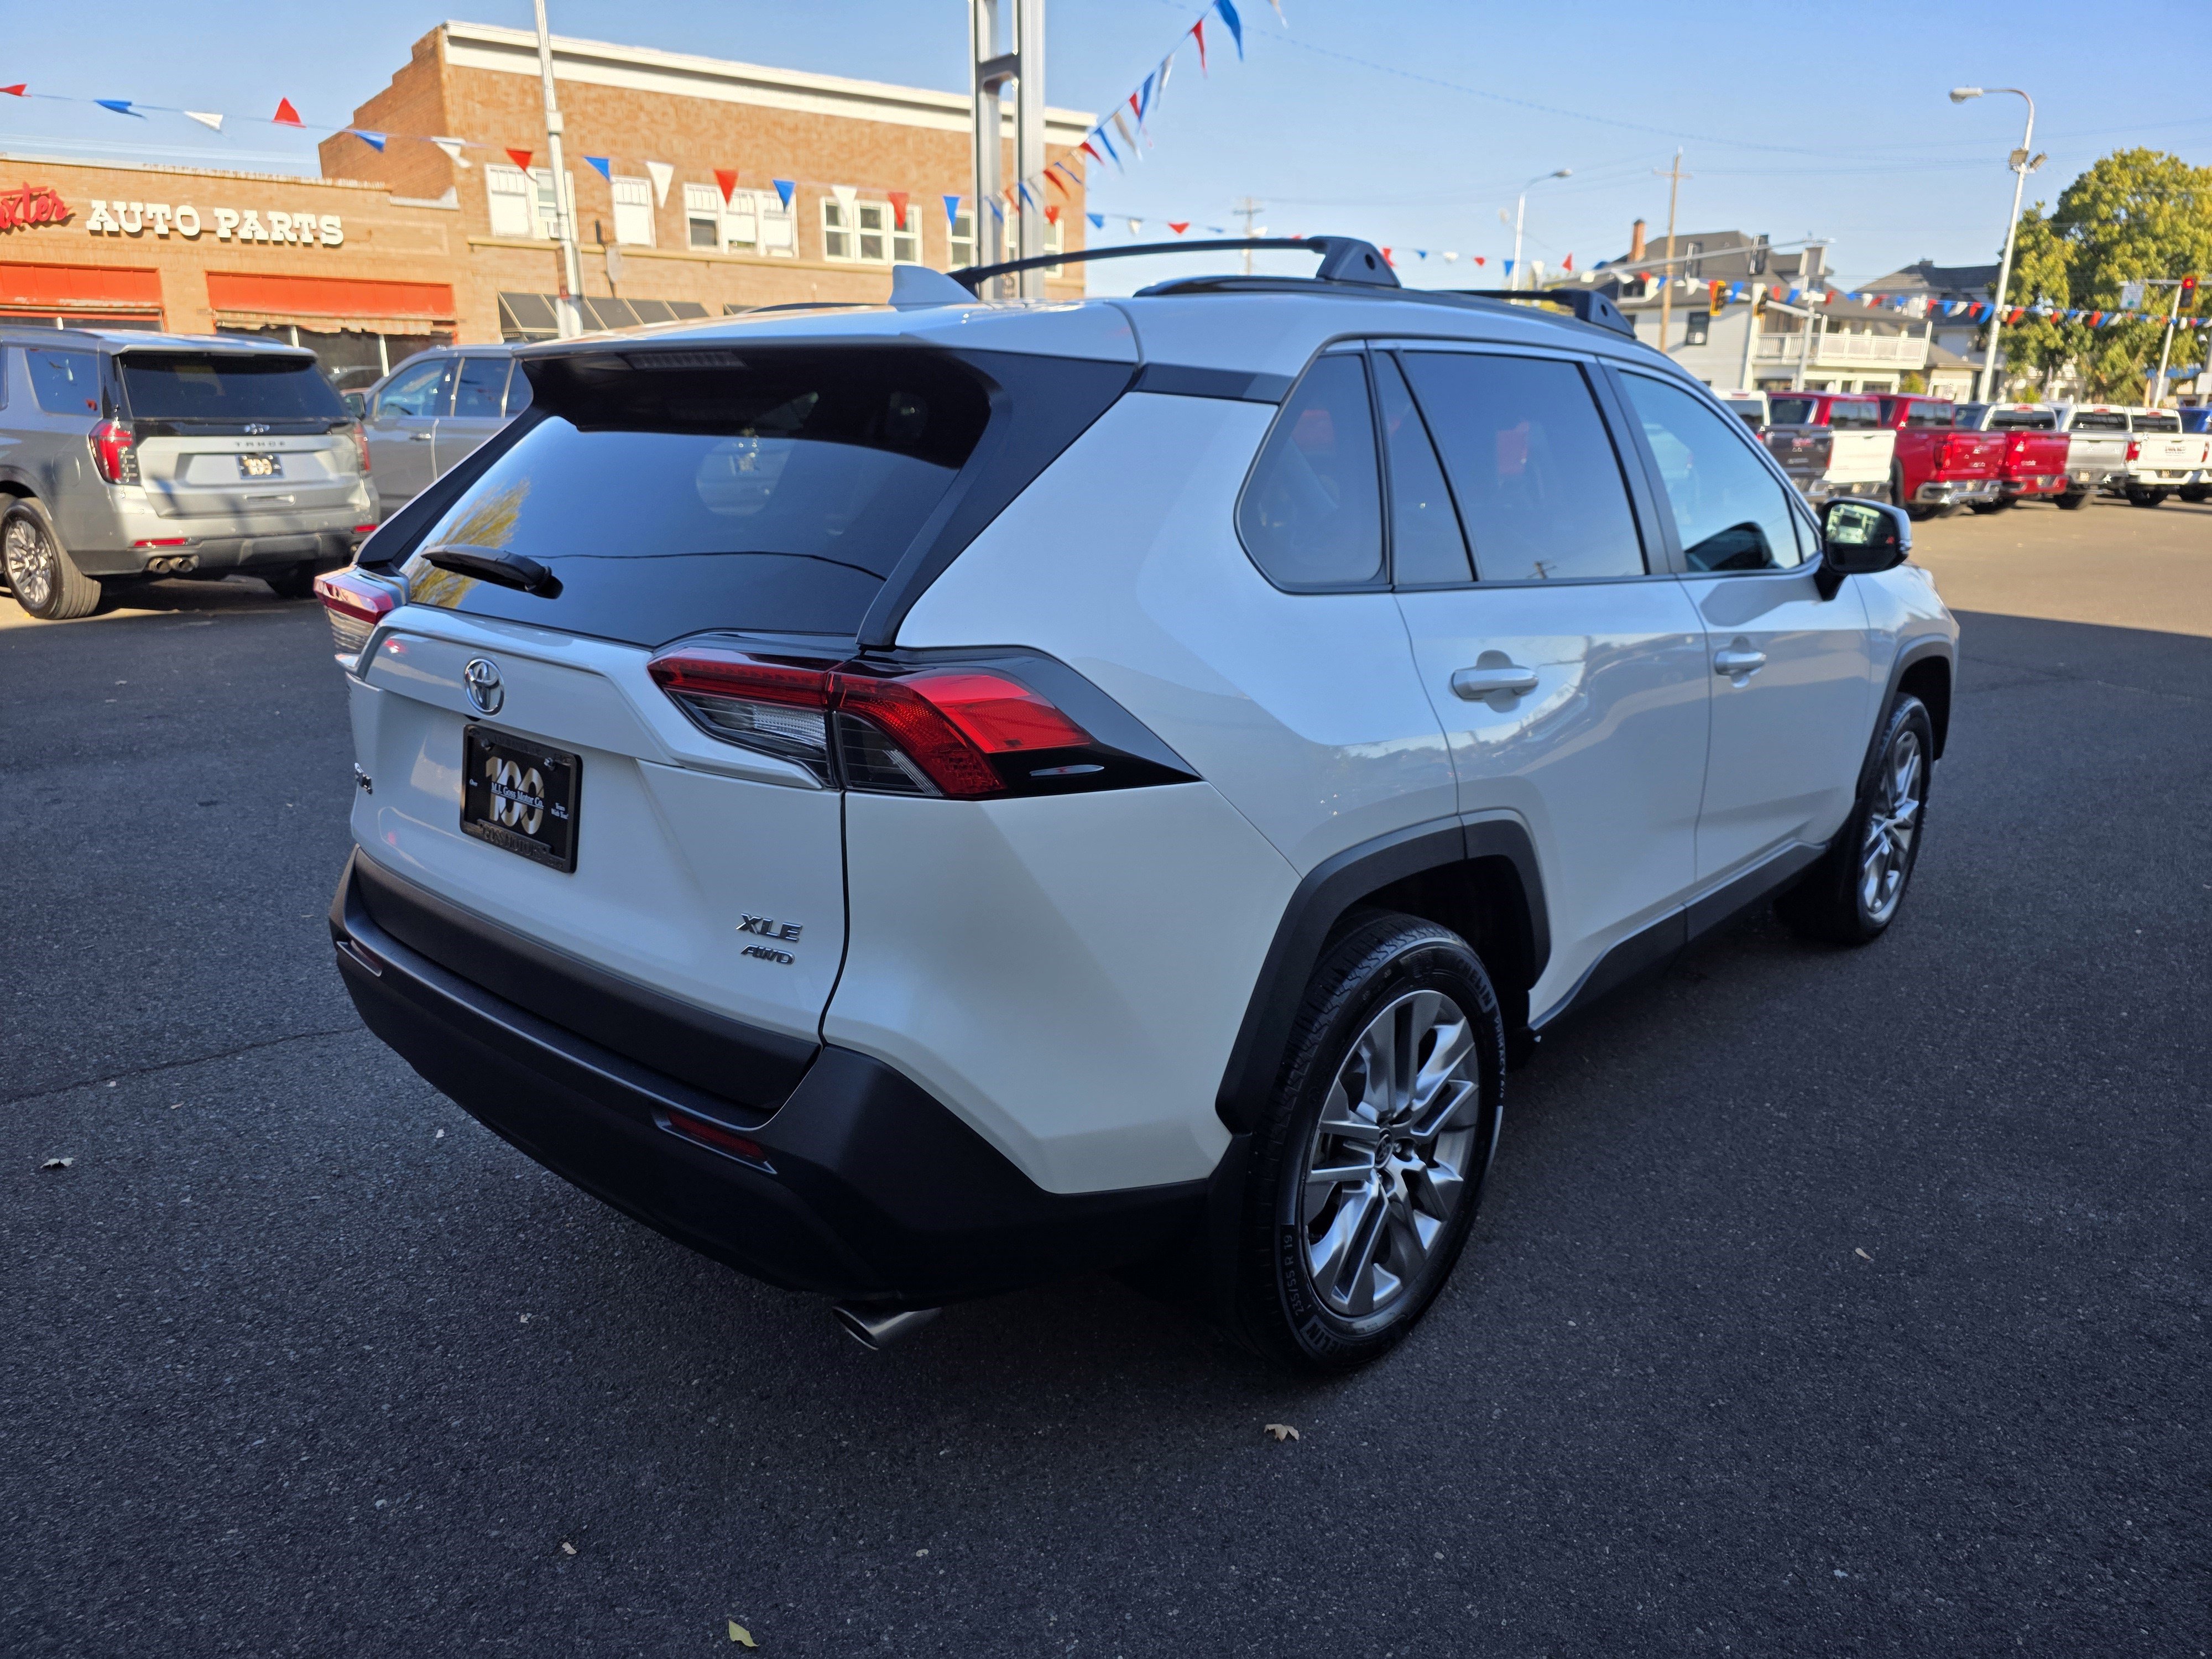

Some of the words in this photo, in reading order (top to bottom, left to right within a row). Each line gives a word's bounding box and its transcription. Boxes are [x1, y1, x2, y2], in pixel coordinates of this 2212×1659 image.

[86, 200, 201, 236] AUTO
[215, 207, 344, 245] PARTS
[503, 786, 516, 799] Goss
[517, 791, 534, 804] Motor
[534, 797, 544, 808] Co.
[735, 912, 804, 943] XLE
[740, 944, 795, 965] AWD
[1283, 1234, 1293, 1250] 19
[1284, 1255, 1294, 1266] R
[1285, 1270, 1305, 1317] 235/55
